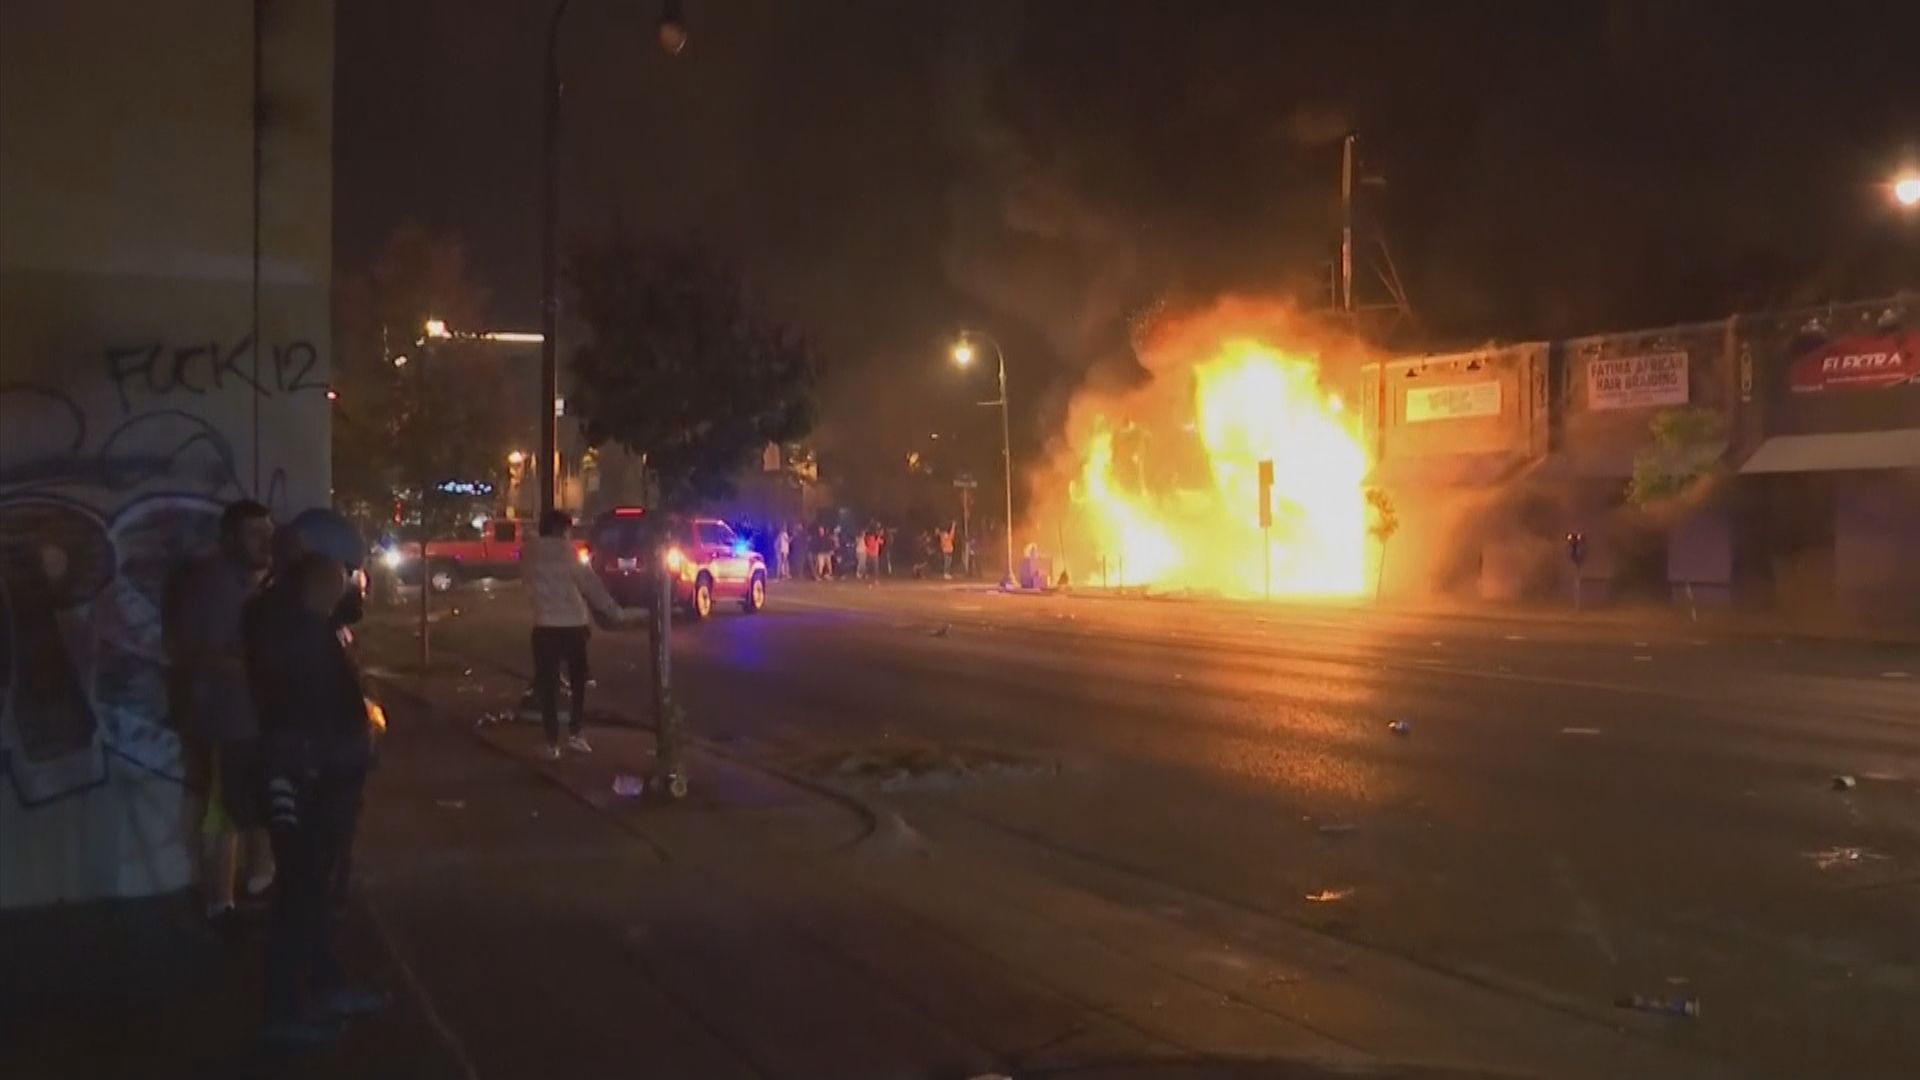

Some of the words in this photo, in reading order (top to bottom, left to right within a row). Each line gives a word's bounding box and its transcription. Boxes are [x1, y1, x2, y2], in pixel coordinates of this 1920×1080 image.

[1591, 361, 1632, 377] FATIMA
[1636, 357, 1683, 373] AFRICAN
[1822, 352, 1901, 371] ELEKTRA
[106, 337, 271, 413] FUCK
[273, 340, 328, 392] 12
[1596, 378, 1621, 391] HAIR
[1625, 373, 1678, 389] BRAIDING
